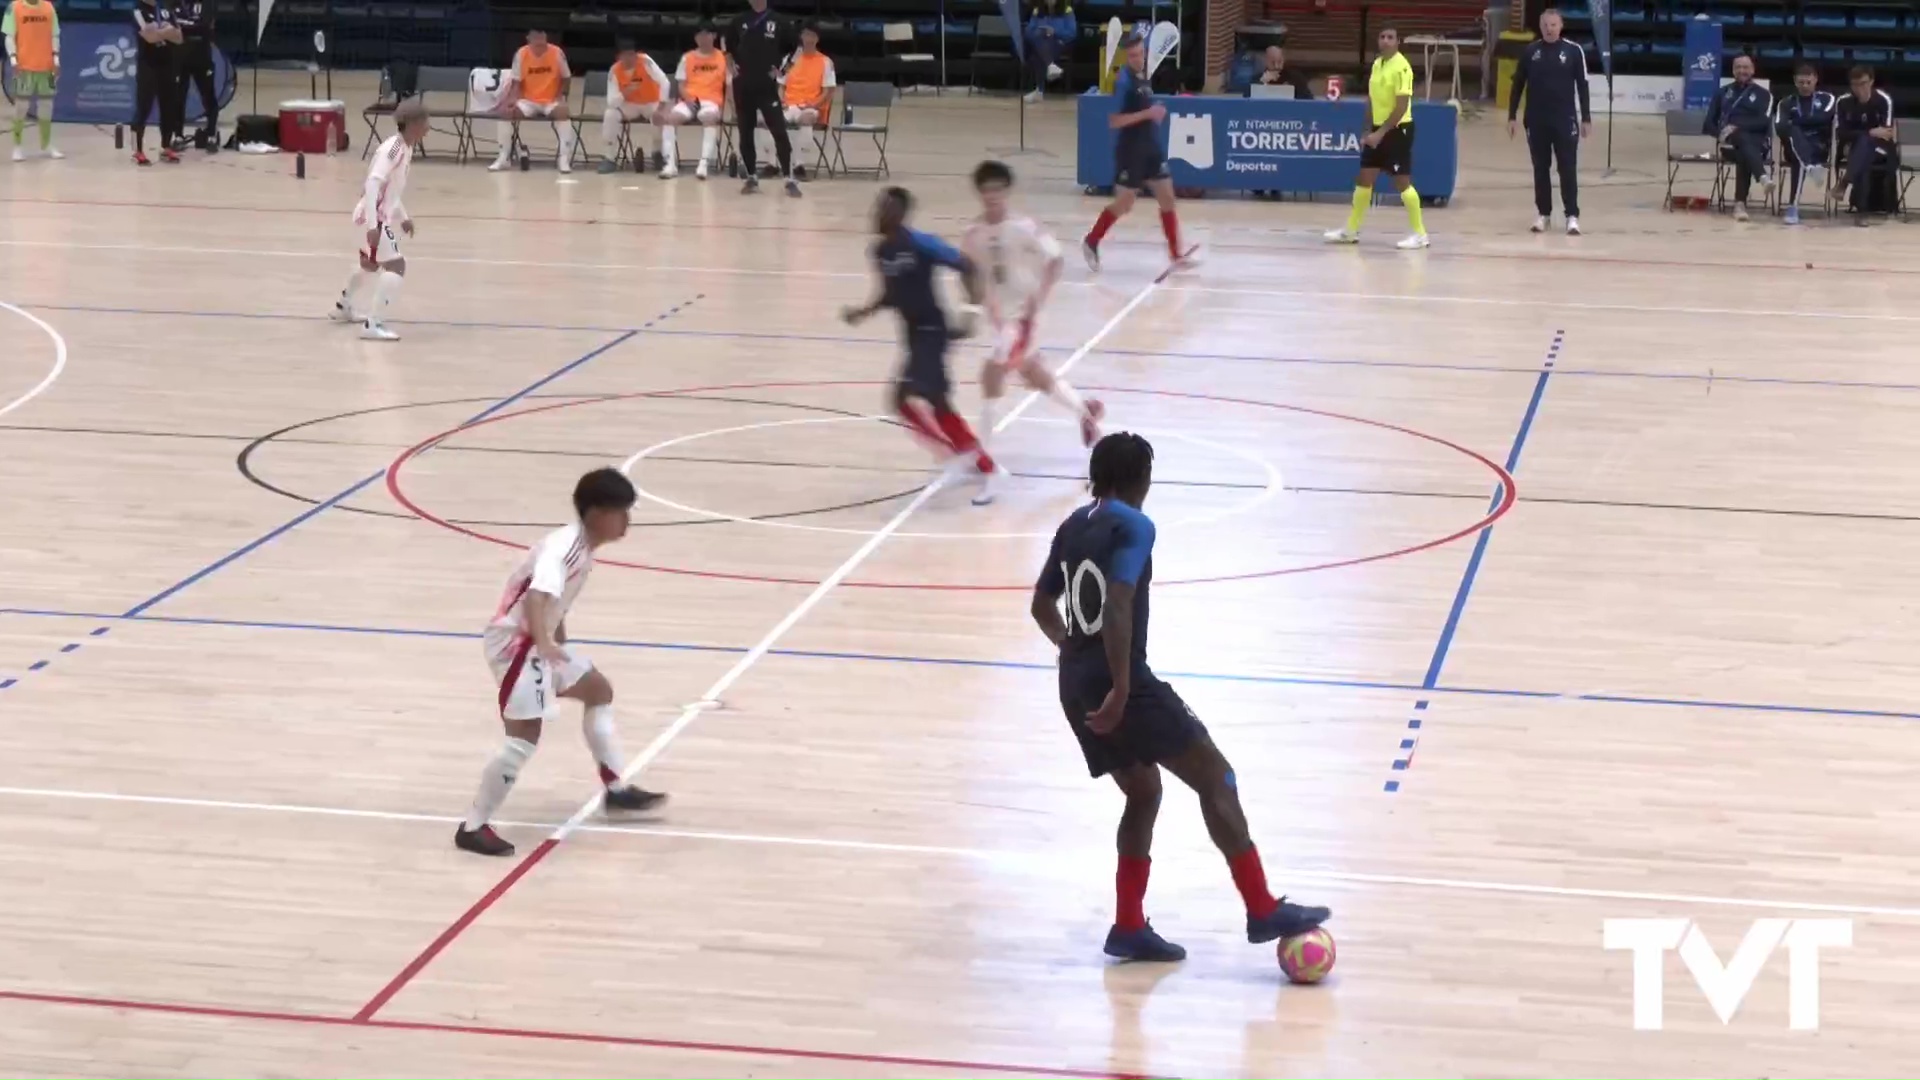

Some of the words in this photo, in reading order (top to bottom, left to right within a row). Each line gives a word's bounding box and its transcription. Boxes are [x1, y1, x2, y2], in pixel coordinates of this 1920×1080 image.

[1327, 79, 1340, 101] 5
[1227, 132, 1361, 151] TORREVIEJA
[1226, 160, 1278, 173] Deportes
[1060, 557, 1107, 637] 10
